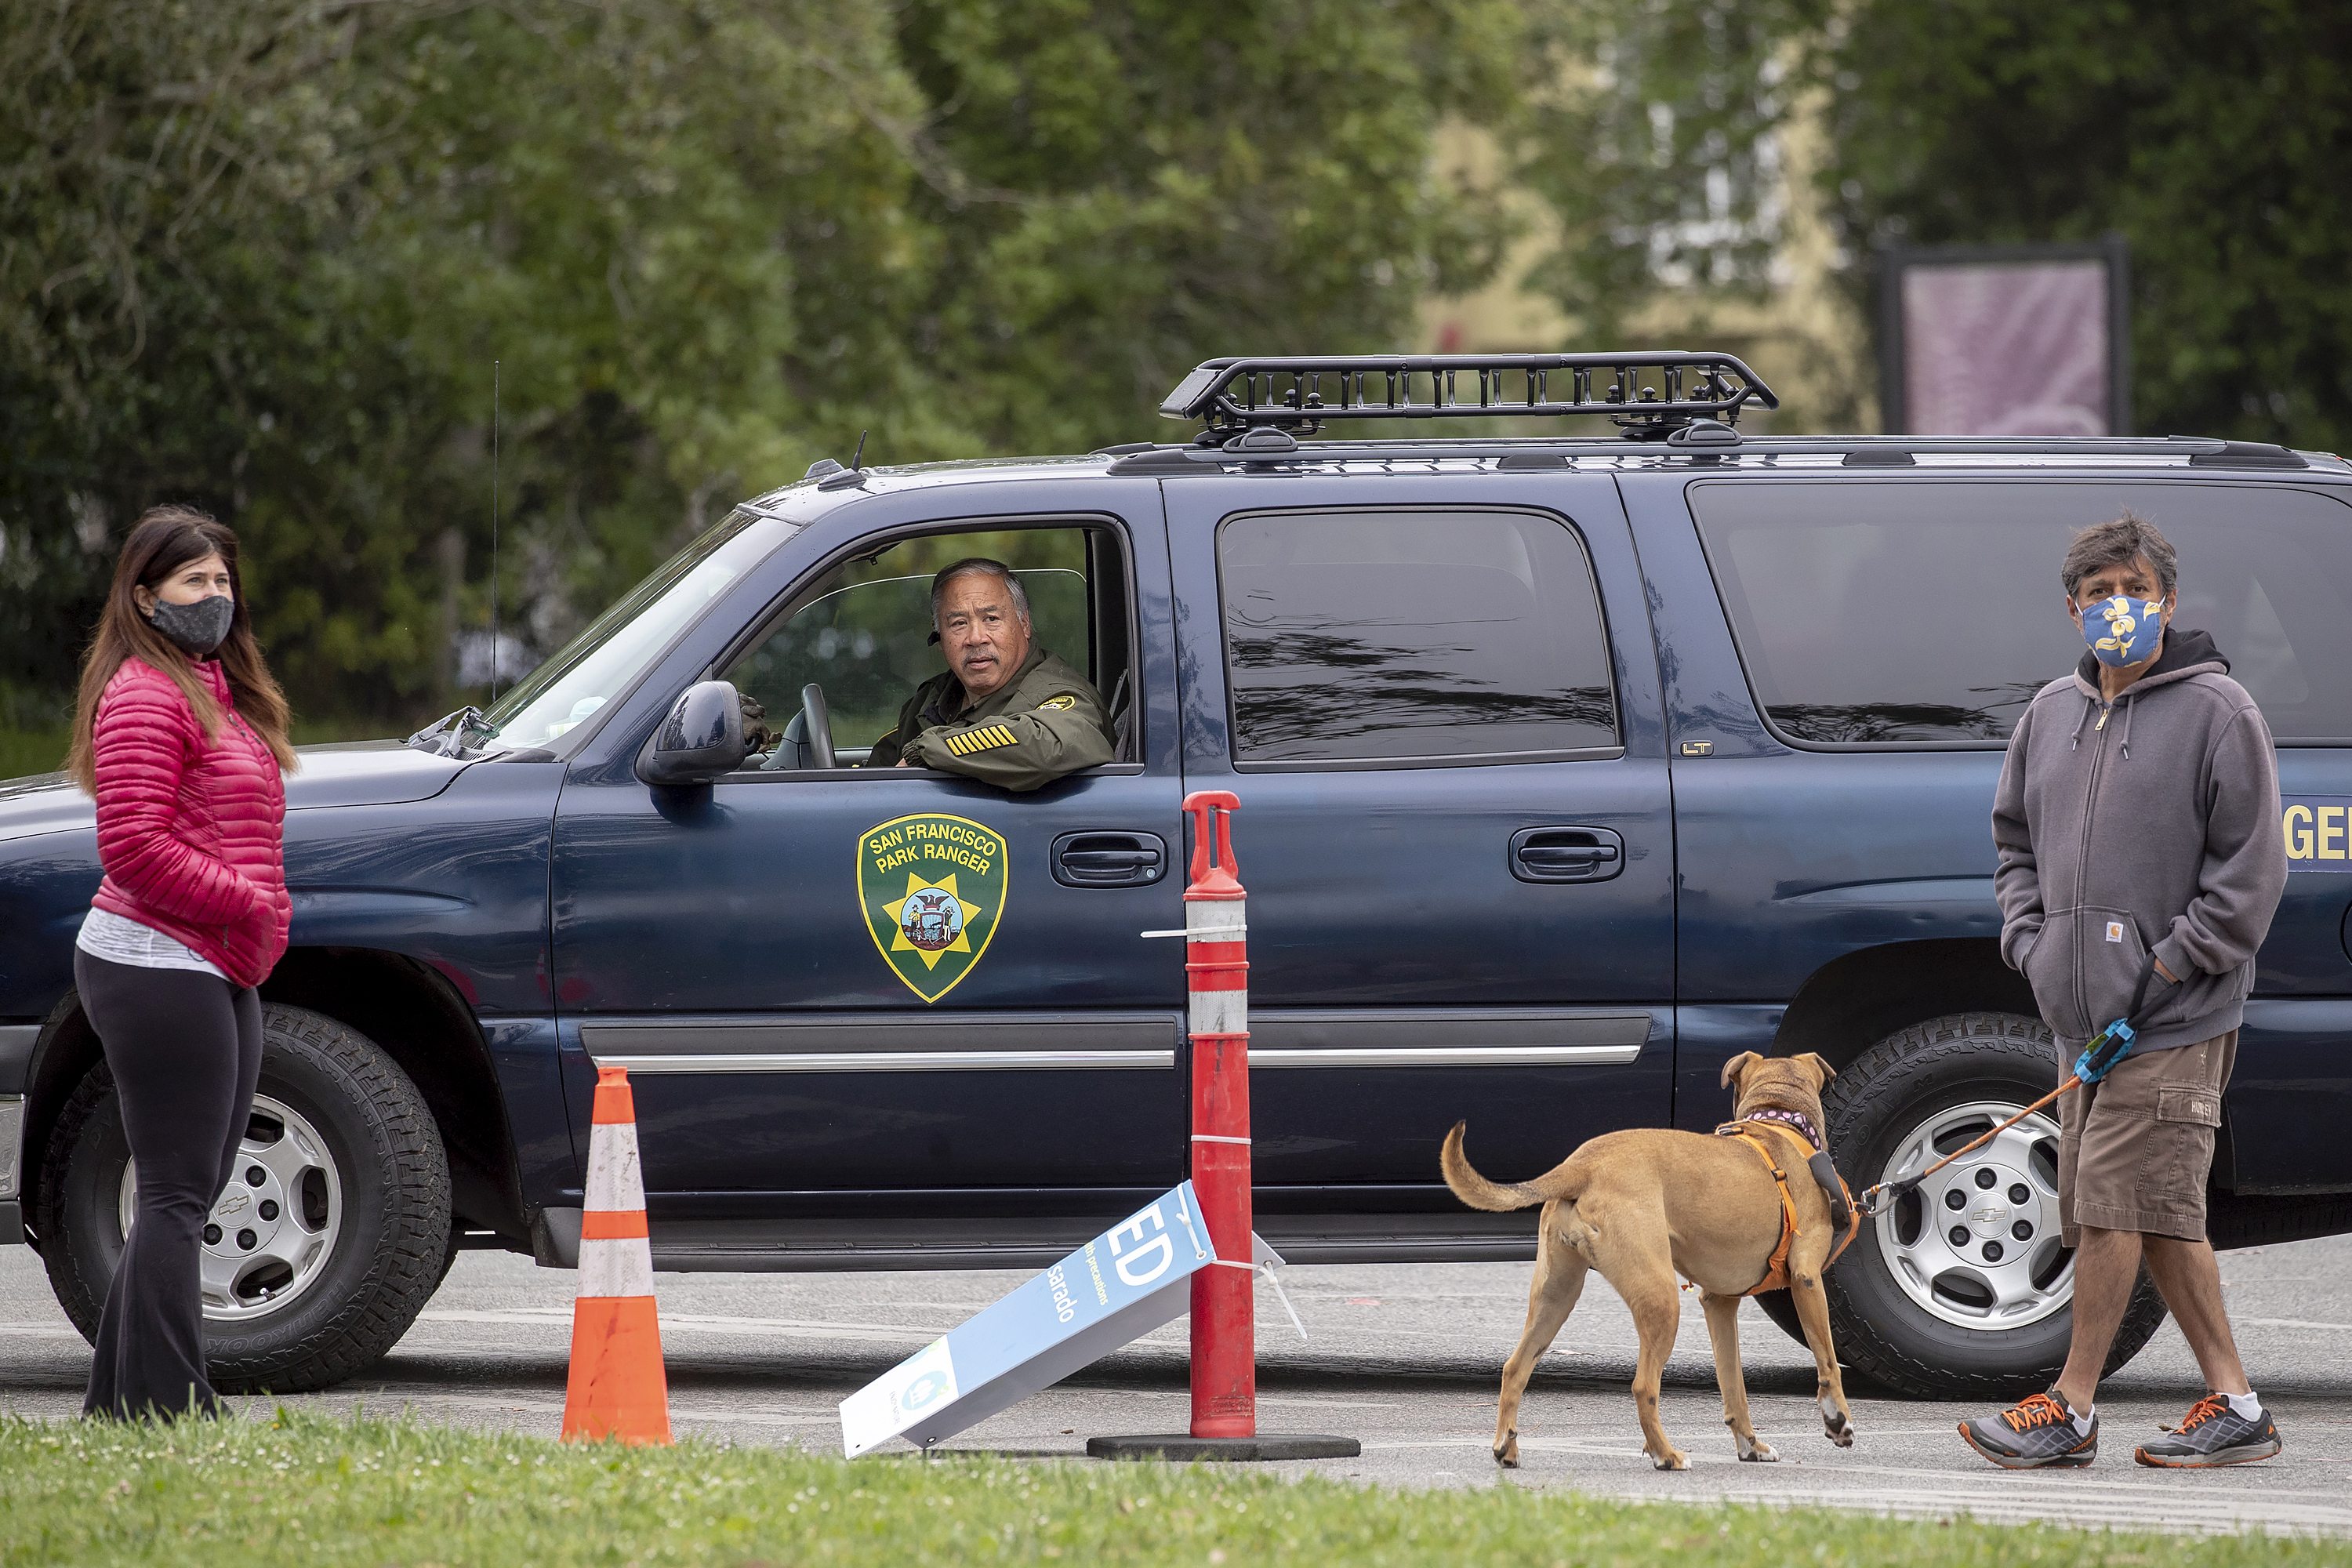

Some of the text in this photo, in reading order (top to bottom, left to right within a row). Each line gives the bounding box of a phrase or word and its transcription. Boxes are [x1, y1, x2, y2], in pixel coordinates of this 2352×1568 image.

[1682, 742, 1711, 754] LT
[869, 823, 996, 857] SAN FRANCISCO
[875, 844, 991, 876] PARK RANGER
[2283, 804, 2352, 860] GE
[1106, 1203, 1174, 1287] ED
[1047, 1265, 1078, 1323] sarado
[1083, 1242, 1109, 1306] lth precautions
